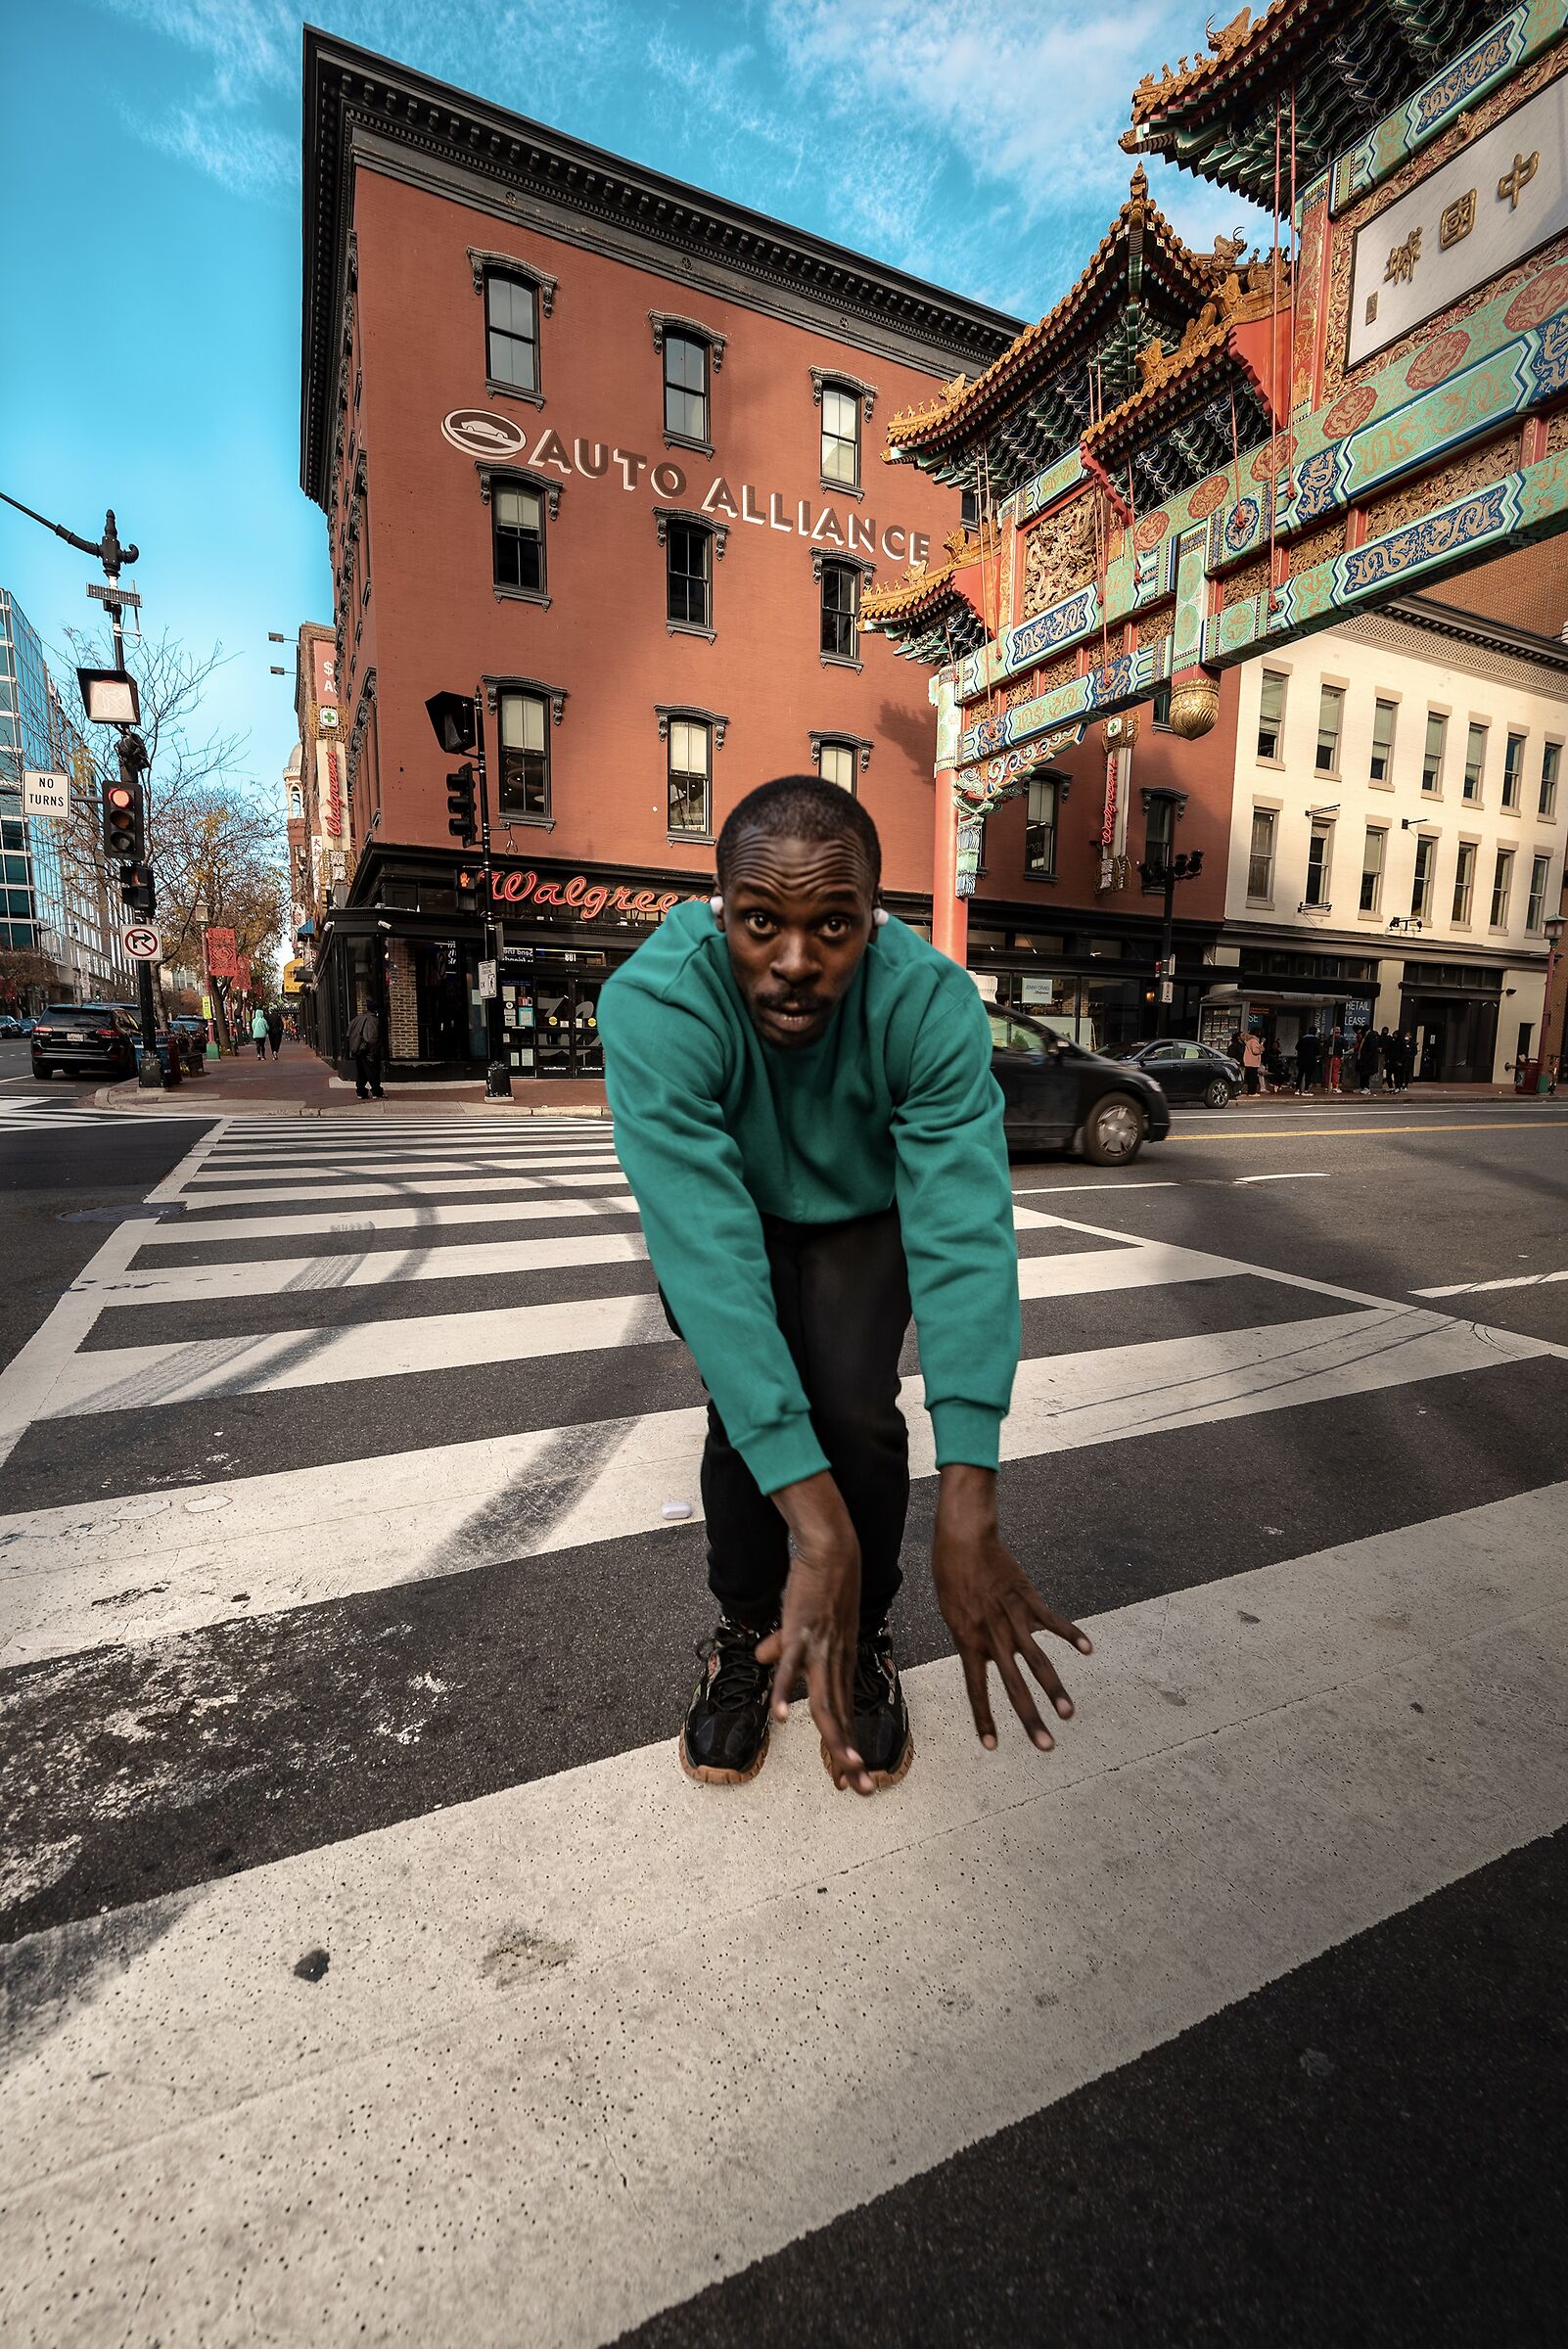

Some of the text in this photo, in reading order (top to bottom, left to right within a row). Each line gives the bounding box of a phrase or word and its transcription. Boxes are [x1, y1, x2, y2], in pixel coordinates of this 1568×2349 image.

[528, 429, 931, 566] AUTO ALLIANCE
[39, 777, 54, 789] NO
[28, 793, 65, 807] TURNS
[325, 751, 346, 838] Walgreens
[1101, 758, 1119, 847] Walgreens
[564, 952, 576, 962] 801
[1345, 1000, 1370, 1011] RETAIL
[1344, 1016, 1366, 1027] LEASE
